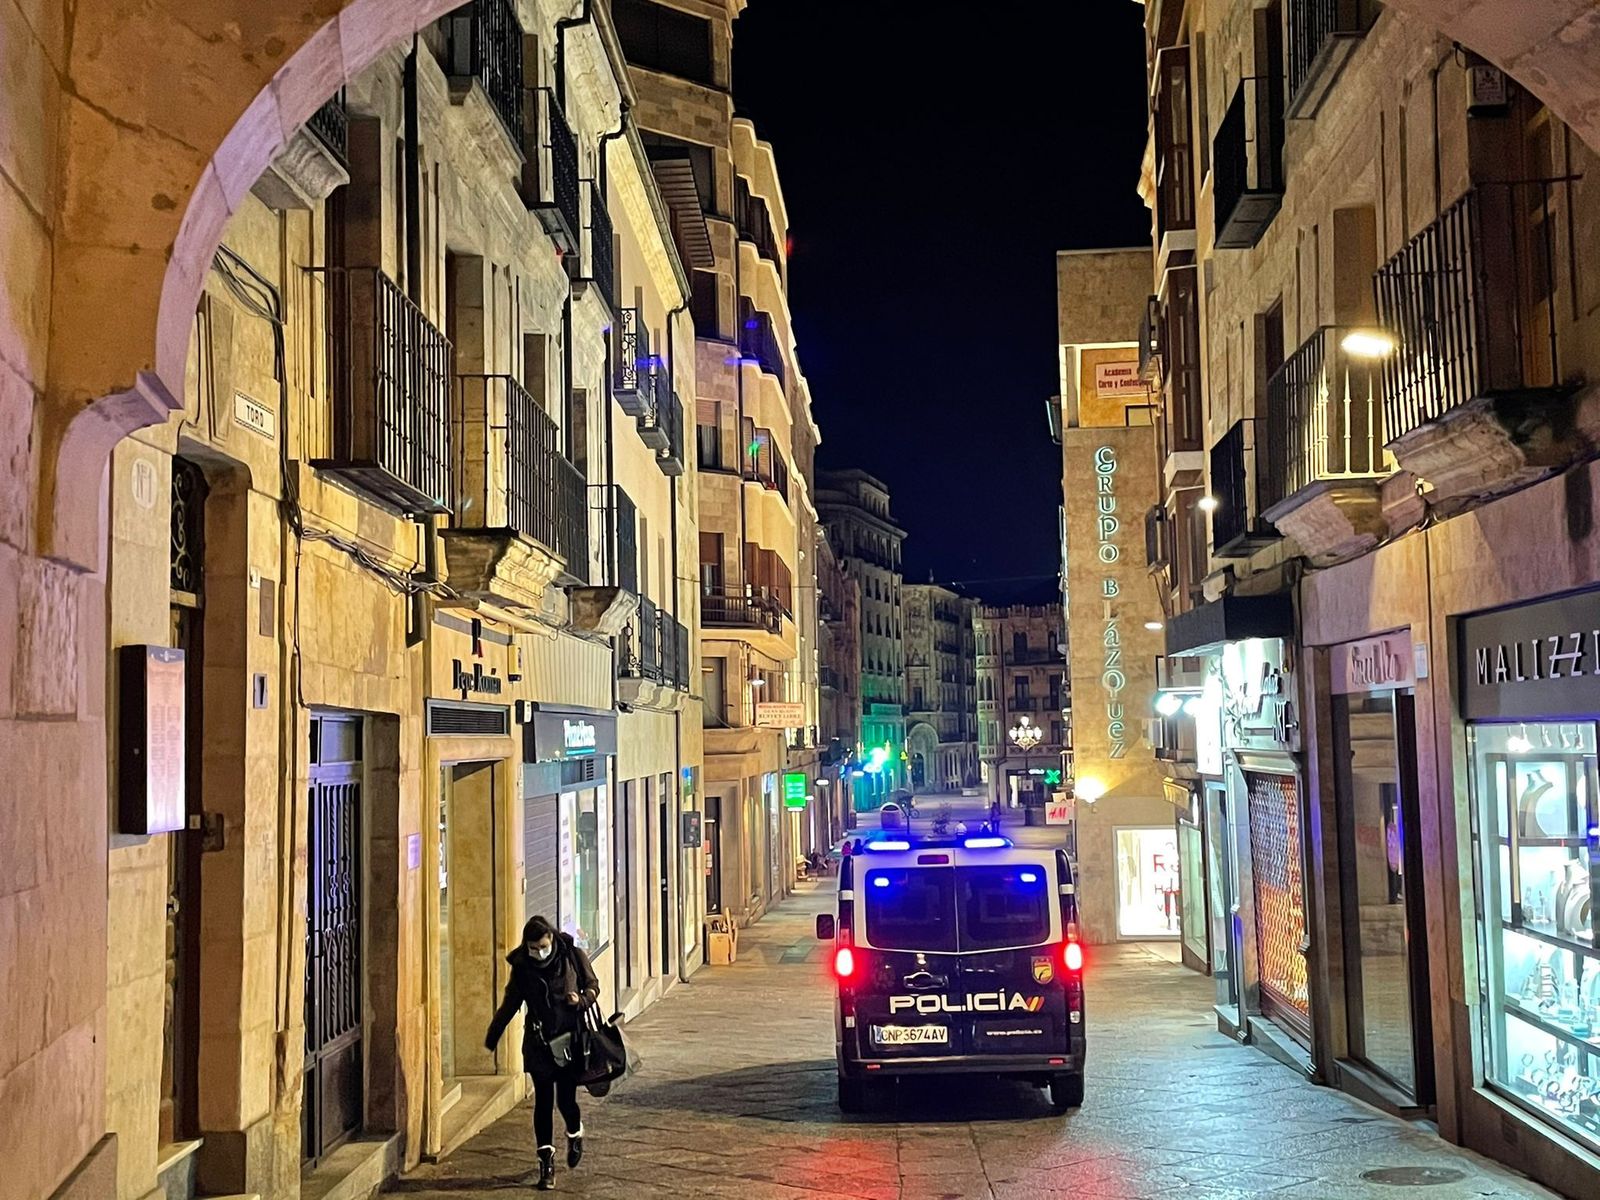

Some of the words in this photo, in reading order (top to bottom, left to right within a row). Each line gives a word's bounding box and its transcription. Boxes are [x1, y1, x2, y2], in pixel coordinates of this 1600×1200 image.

[246, 404, 264, 428] TORO
[1094, 446, 1119, 563] GRUPO
[1475, 629, 1600, 686] MALIZZI
